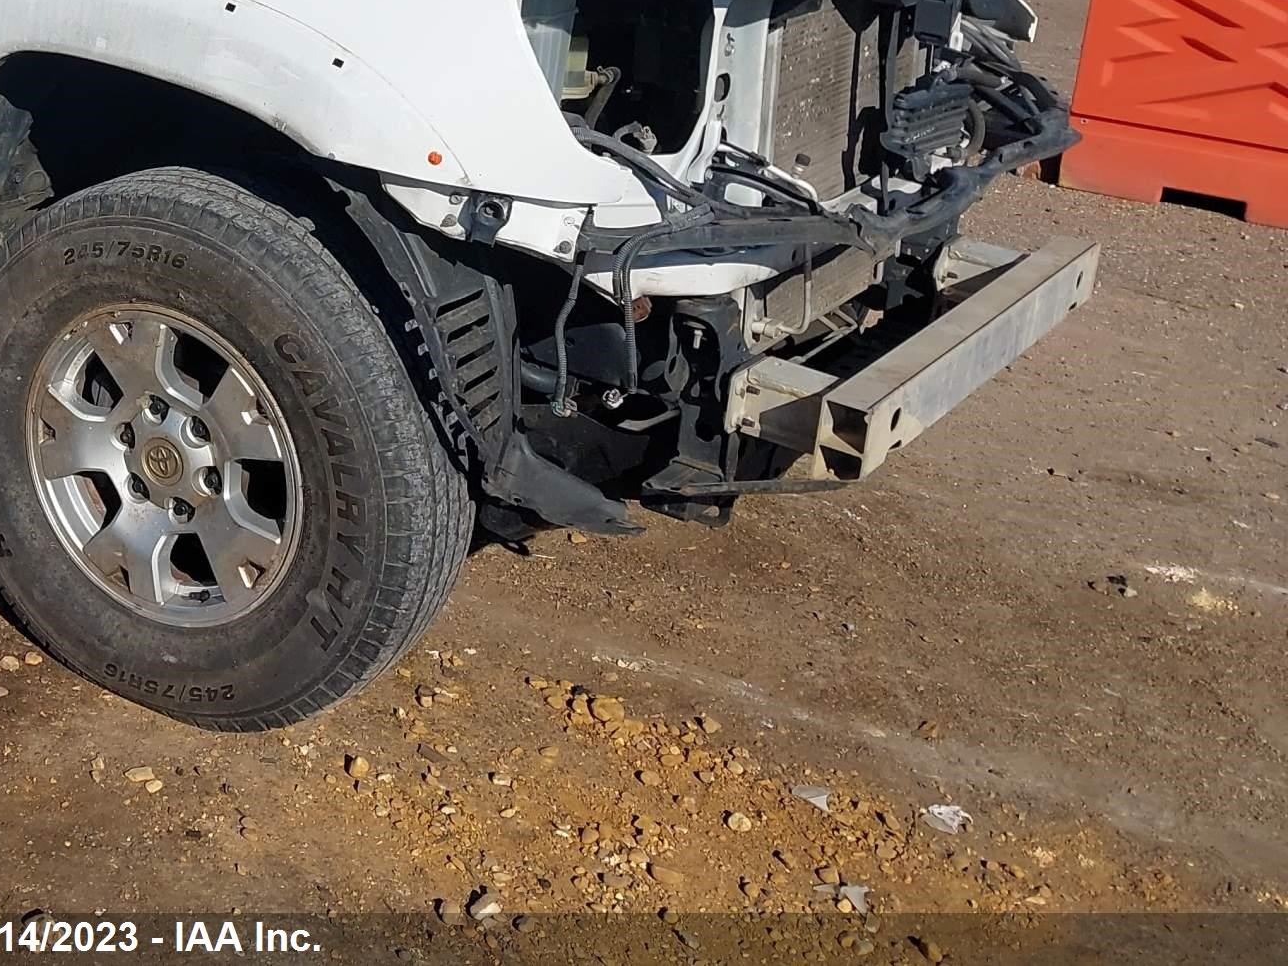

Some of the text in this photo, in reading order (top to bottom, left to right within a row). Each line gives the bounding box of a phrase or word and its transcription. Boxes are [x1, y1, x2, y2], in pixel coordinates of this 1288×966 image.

[63, 240, 189, 270] 245/75R16
[273, 334, 367, 564] CAVALRY
[102, 661, 236, 703] 245/75R16
